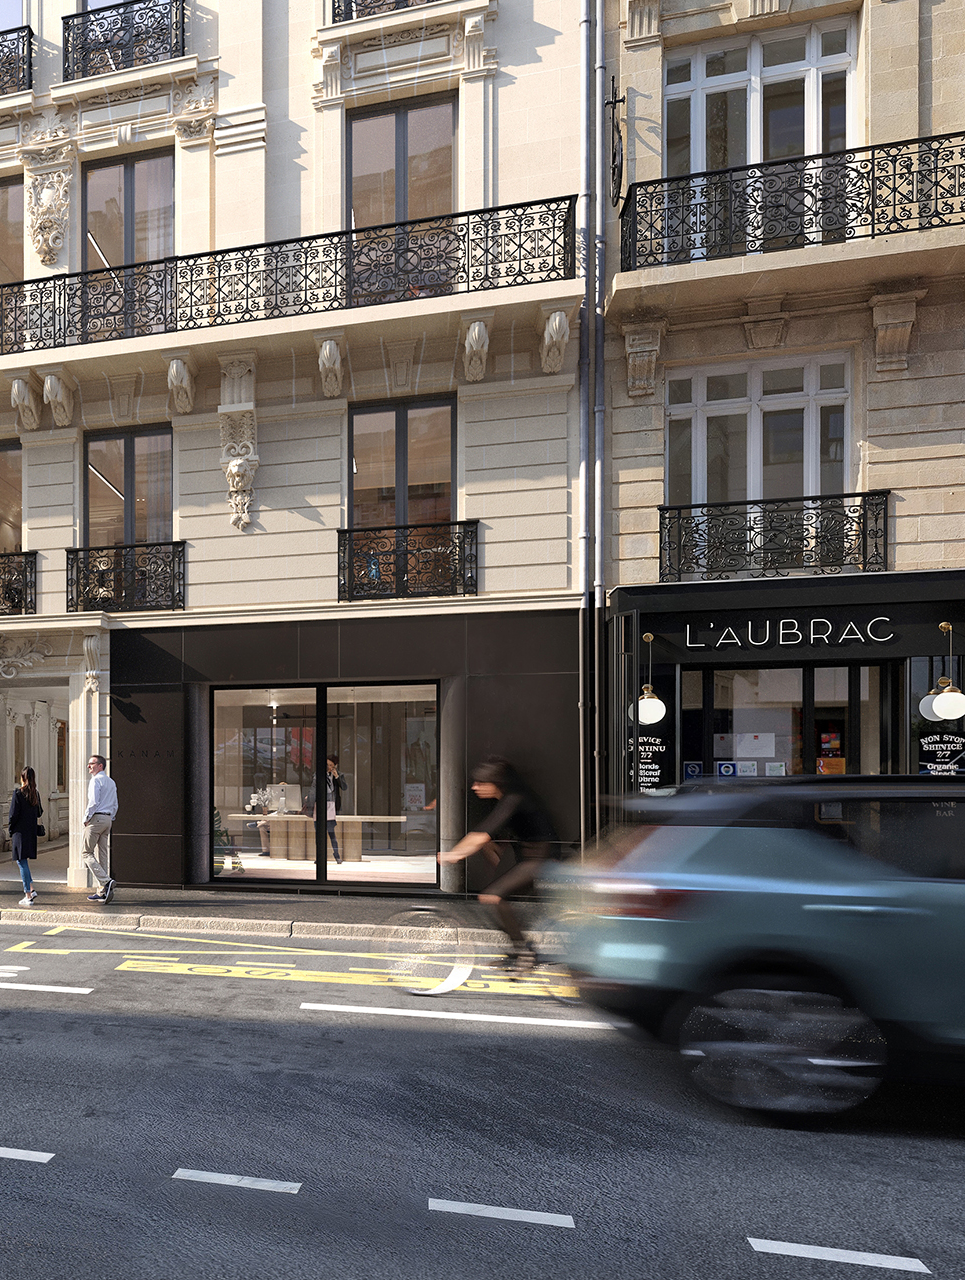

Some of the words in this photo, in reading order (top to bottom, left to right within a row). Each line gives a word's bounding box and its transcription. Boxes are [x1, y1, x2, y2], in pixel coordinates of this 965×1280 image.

[686, 616, 894, 648] L'AUBRAC
[920, 734, 940, 745] NON
[117, 750, 175, 758] KANAM
